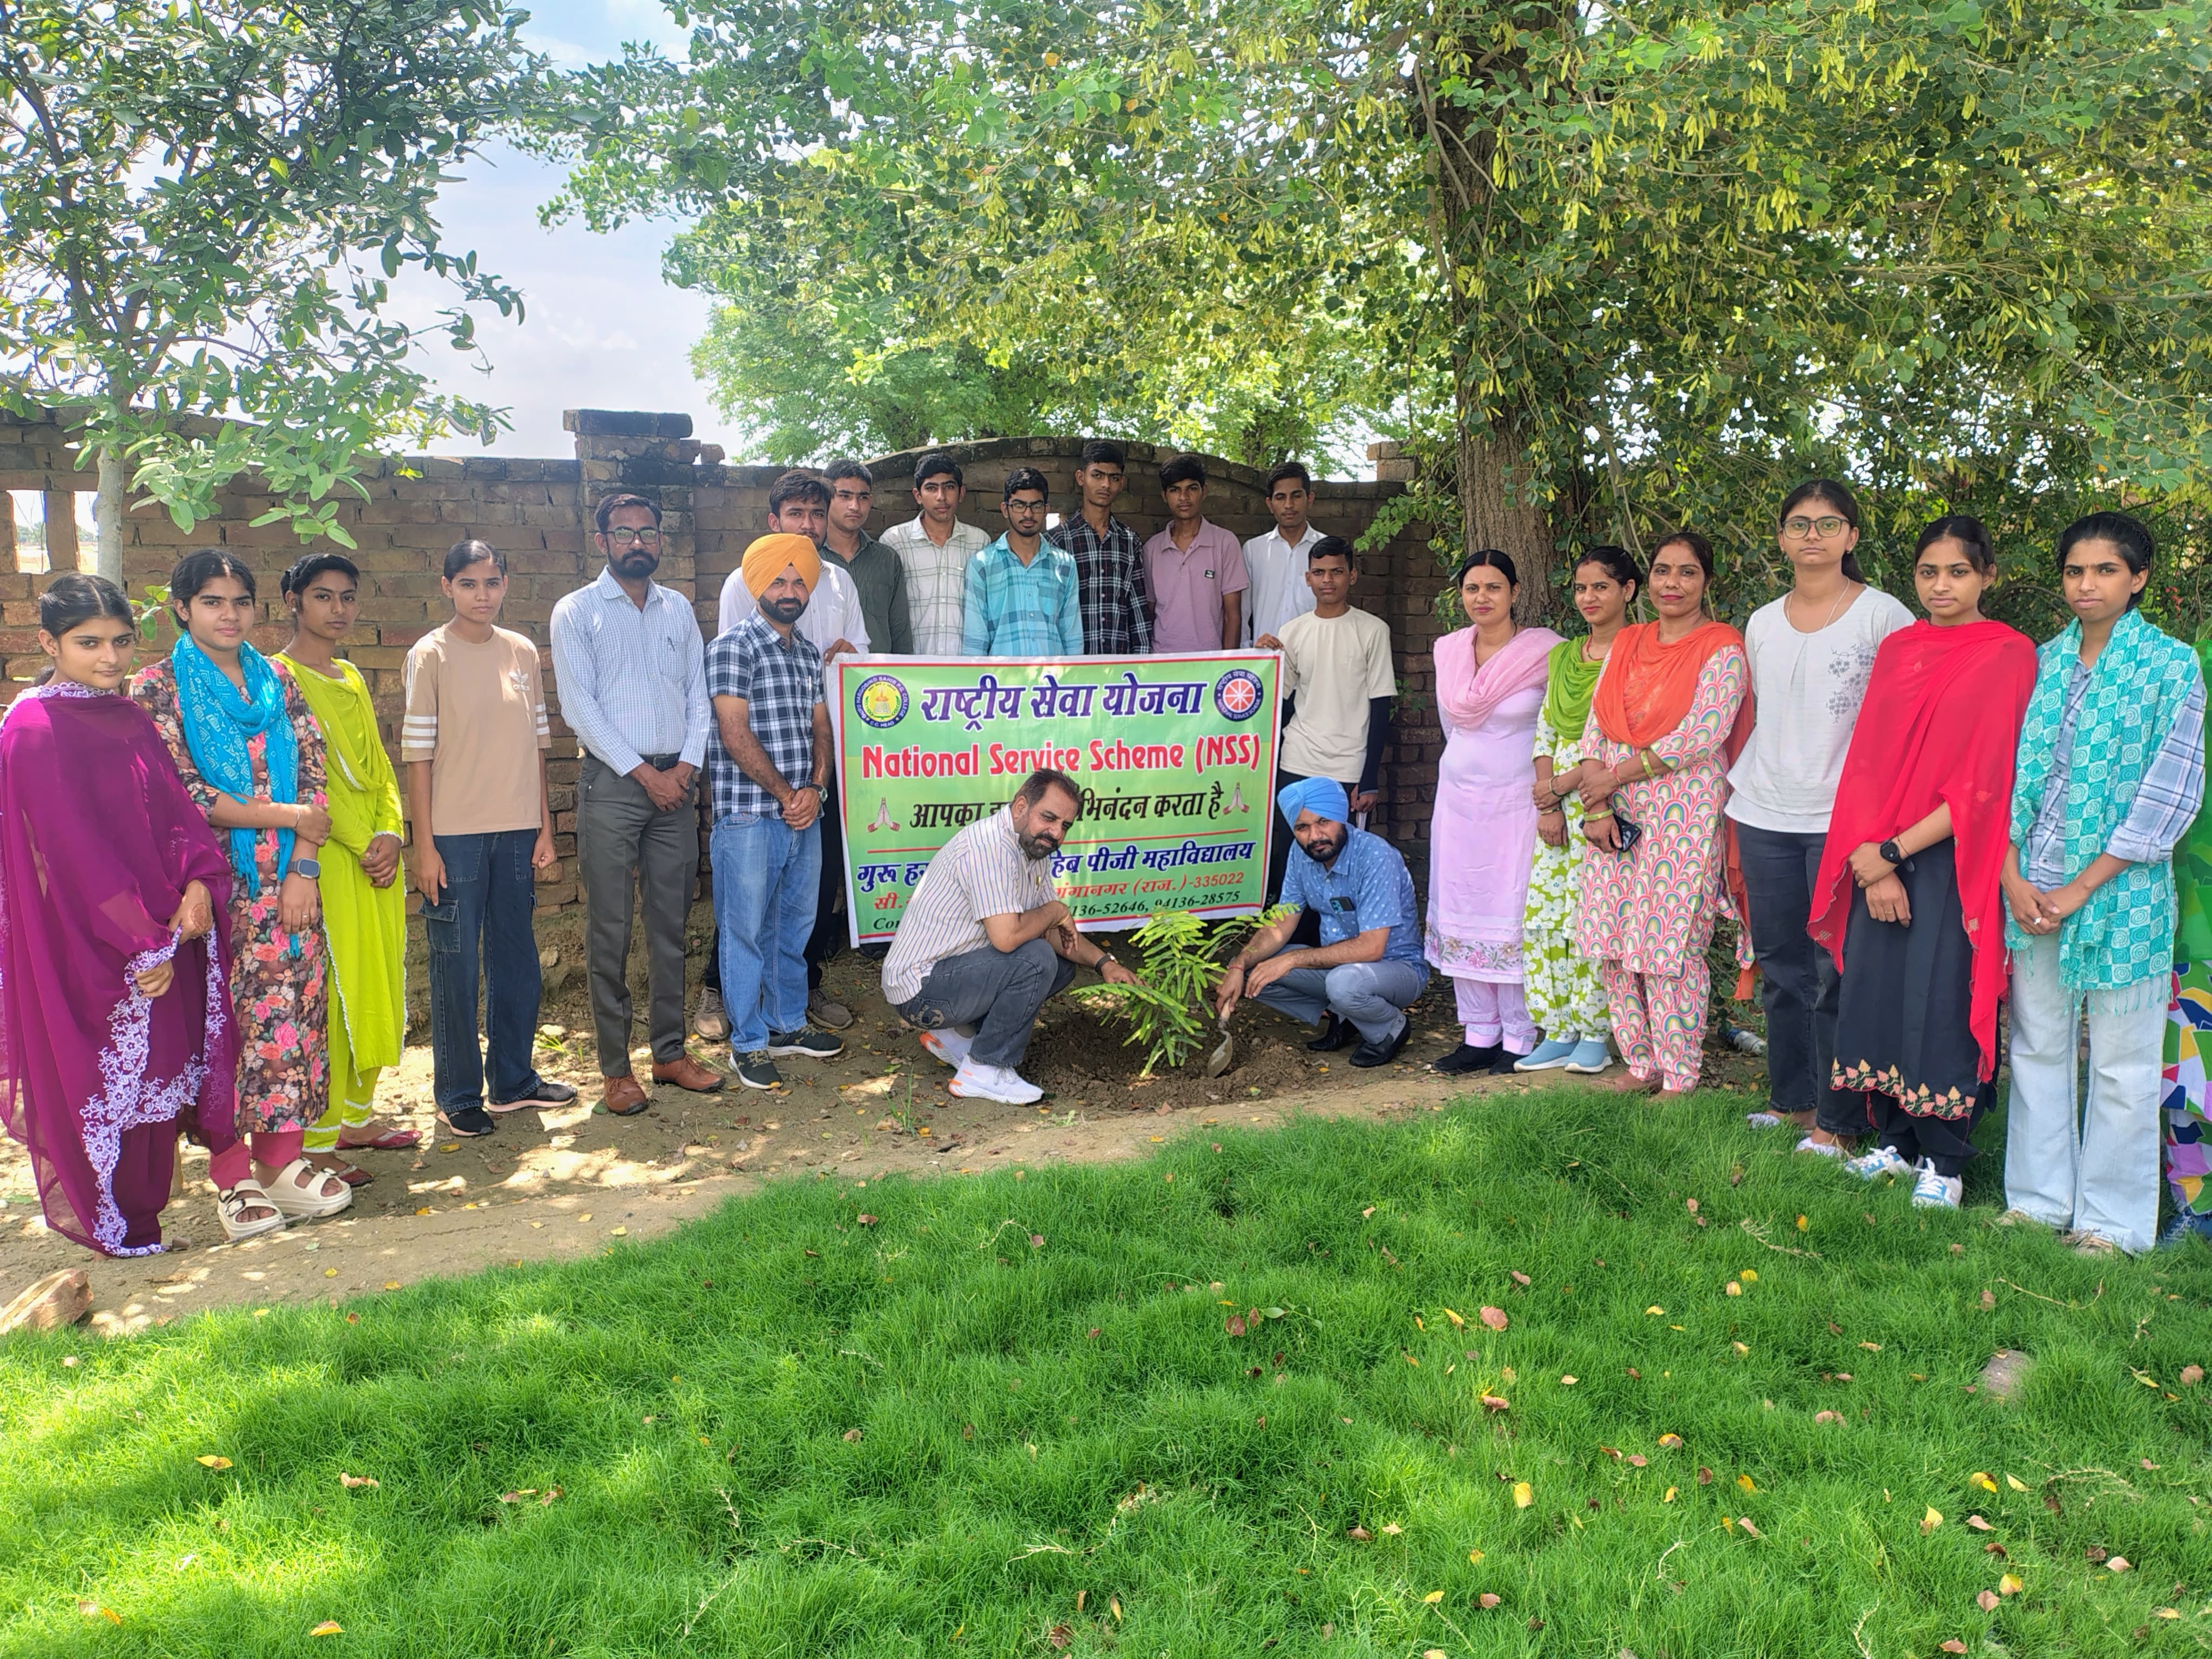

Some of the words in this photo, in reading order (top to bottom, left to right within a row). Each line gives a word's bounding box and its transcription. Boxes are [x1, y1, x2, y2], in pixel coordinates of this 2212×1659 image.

[921, 675, 1026, 731] राष्ट्रीय
[1030, 675, 1098, 718] सेवा
[1103, 672, 1208, 716] योजना
[862, 744, 979, 778] National
[988, 741, 1080, 774] Service
[1089, 738, 1184, 771] Scheme
[1195, 733, 1260, 774] (NSS)
[911, 802, 985, 827] आपका
[1076, 786, 1151, 821] भिनंदन
[1154, 792, 1207, 818] करता
[1208, 780, 1224, 819] है
[1087, 846, 1139, 872] पीजी
[1141, 841, 1256, 872] महाविद्यालय
